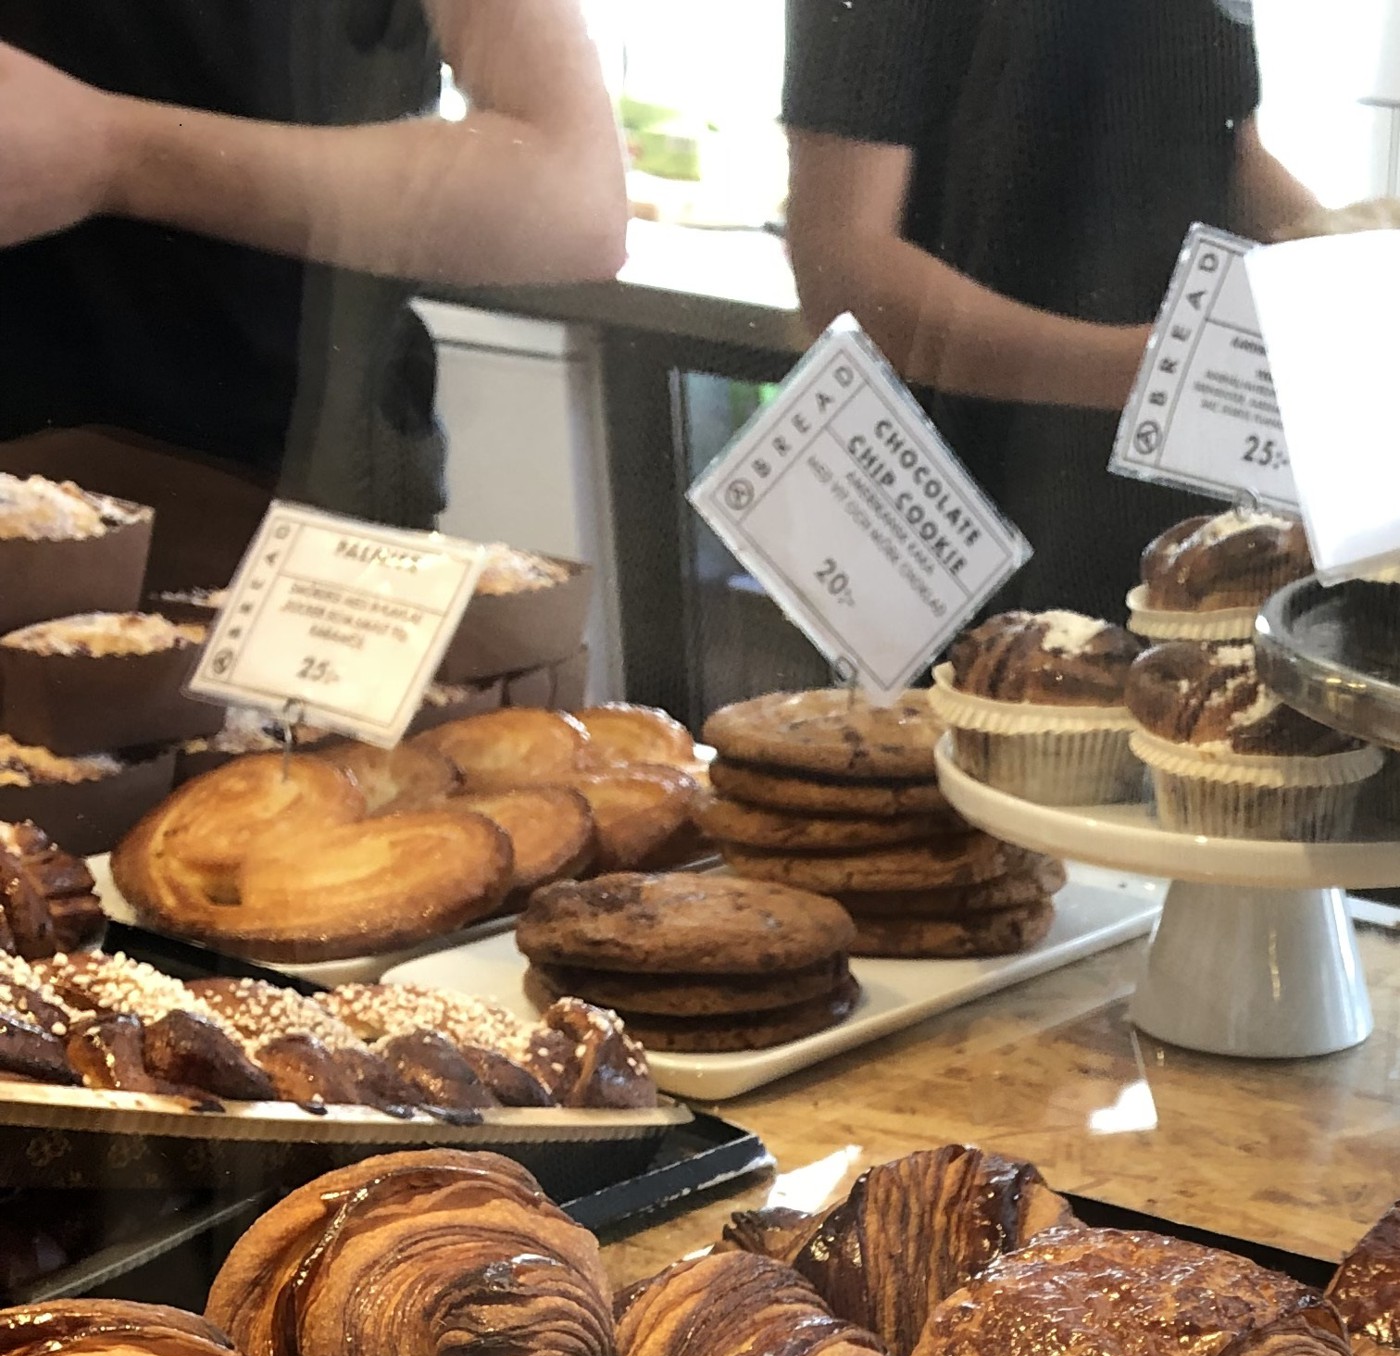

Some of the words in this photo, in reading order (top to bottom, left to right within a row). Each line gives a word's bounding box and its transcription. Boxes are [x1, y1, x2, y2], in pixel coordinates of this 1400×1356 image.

[1148, 252, 1219, 406] BREAD
[751, 365, 855, 479] BREAD
[873, 418, 983, 548] CHOCOLATE
[847, 434, 898, 487] CHIP
[895, 492, 969, 577] COOKIE
